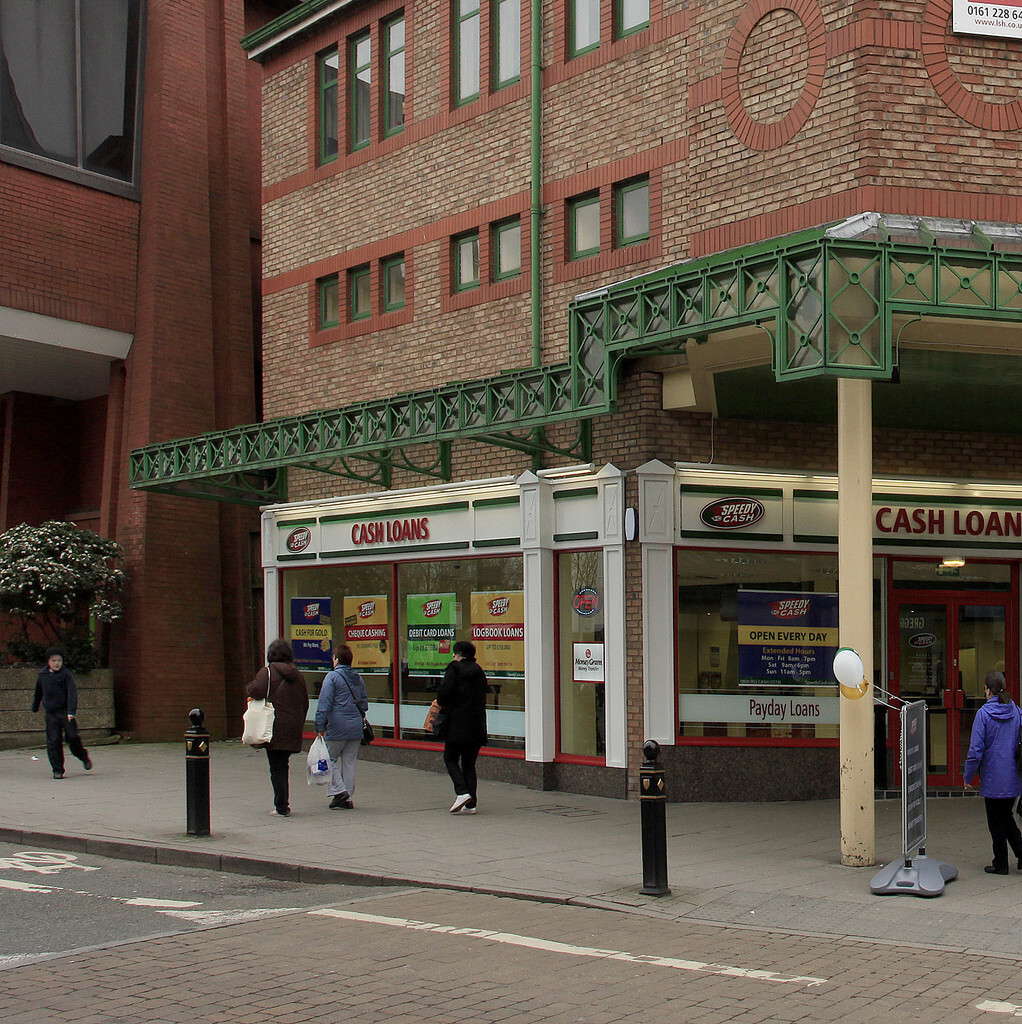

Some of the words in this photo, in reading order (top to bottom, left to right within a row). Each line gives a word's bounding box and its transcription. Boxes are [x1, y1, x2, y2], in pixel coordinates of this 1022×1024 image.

[967, 5, 989, 17] 0161
[992, 7, 1010, 19] 228
[721, 502, 757, 516] SPEEDY
[722, 513, 755, 523] CASH
[875, 507, 945, 535] CASH
[351, 520, 385, 545] CASH
[387, 517, 430, 542] LOANS
[361, 601, 375, 611] SPEEDY
[427, 600, 442, 610] SPEEDY
[492, 598, 510, 609] SPEEDY
[573, 594, 600, 609] OPEN
[779, 598, 810, 610] SPEEDY
[361, 609, 374, 617] CASH
[492, 606, 508, 615] CASH
[780, 608, 807, 616] CASH
[295, 629, 307, 637] CASH
[315, 628, 328, 636] GOLD
[348, 629, 365, 638] CHEQUE
[365, 628, 386, 637] CASHING
[408, 629, 423, 638] DEBIT
[423, 628, 437, 637] CARD
[437, 628, 455, 637] LOANS
[473, 628, 502, 638] LOGBOOK
[503, 627, 524, 637] LOANS
[749, 631, 775, 641] OPEN
[777, 631, 806, 641] EVERY
[808, 632, 827, 642] DAY
[762, 647, 794, 655] Extended
[795, 647, 816, 655] Hours
[575, 658, 603, 667] MoneyGram
[749, 698, 787, 721] Payday
[790, 699, 820, 717] Loans
